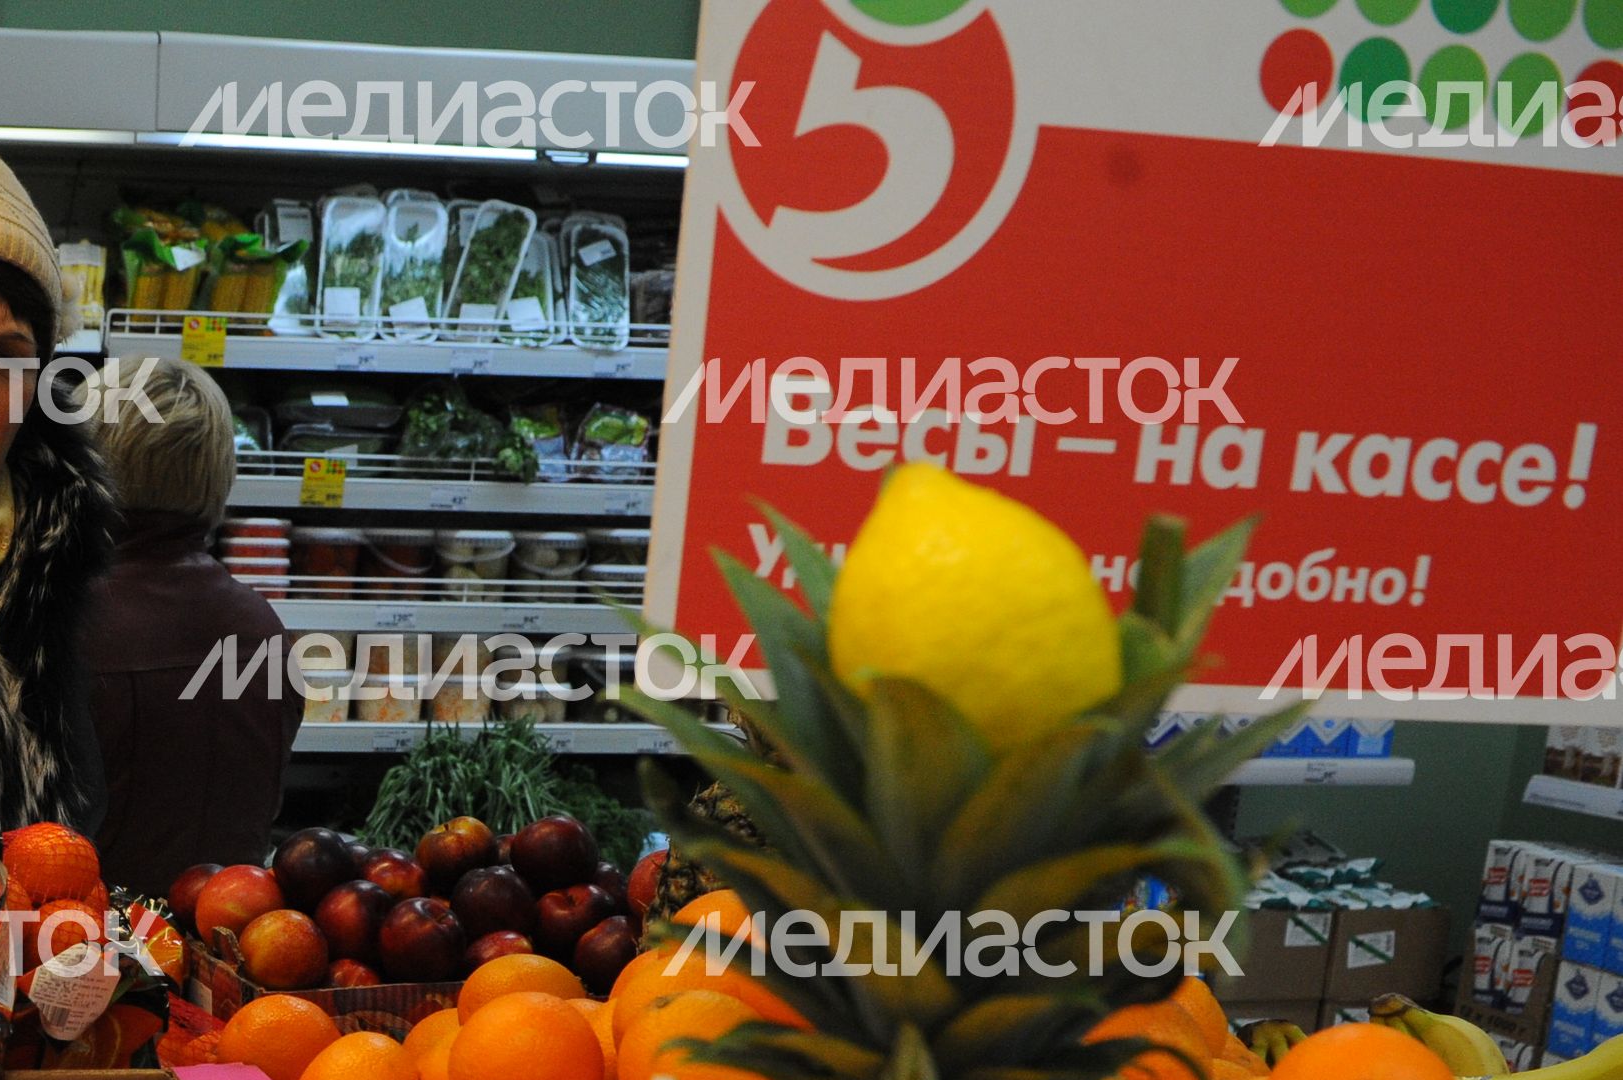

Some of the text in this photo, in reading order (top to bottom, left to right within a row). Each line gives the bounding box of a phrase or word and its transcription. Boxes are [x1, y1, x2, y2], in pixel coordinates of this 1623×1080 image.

[769, 29, 956, 261] 5
[761, 372, 1037, 477] Весы
[1134, 420, 1266, 490] на
[1289, 422, 1598, 510] кассе!
[1215, 547, 1431, 608] добно!
